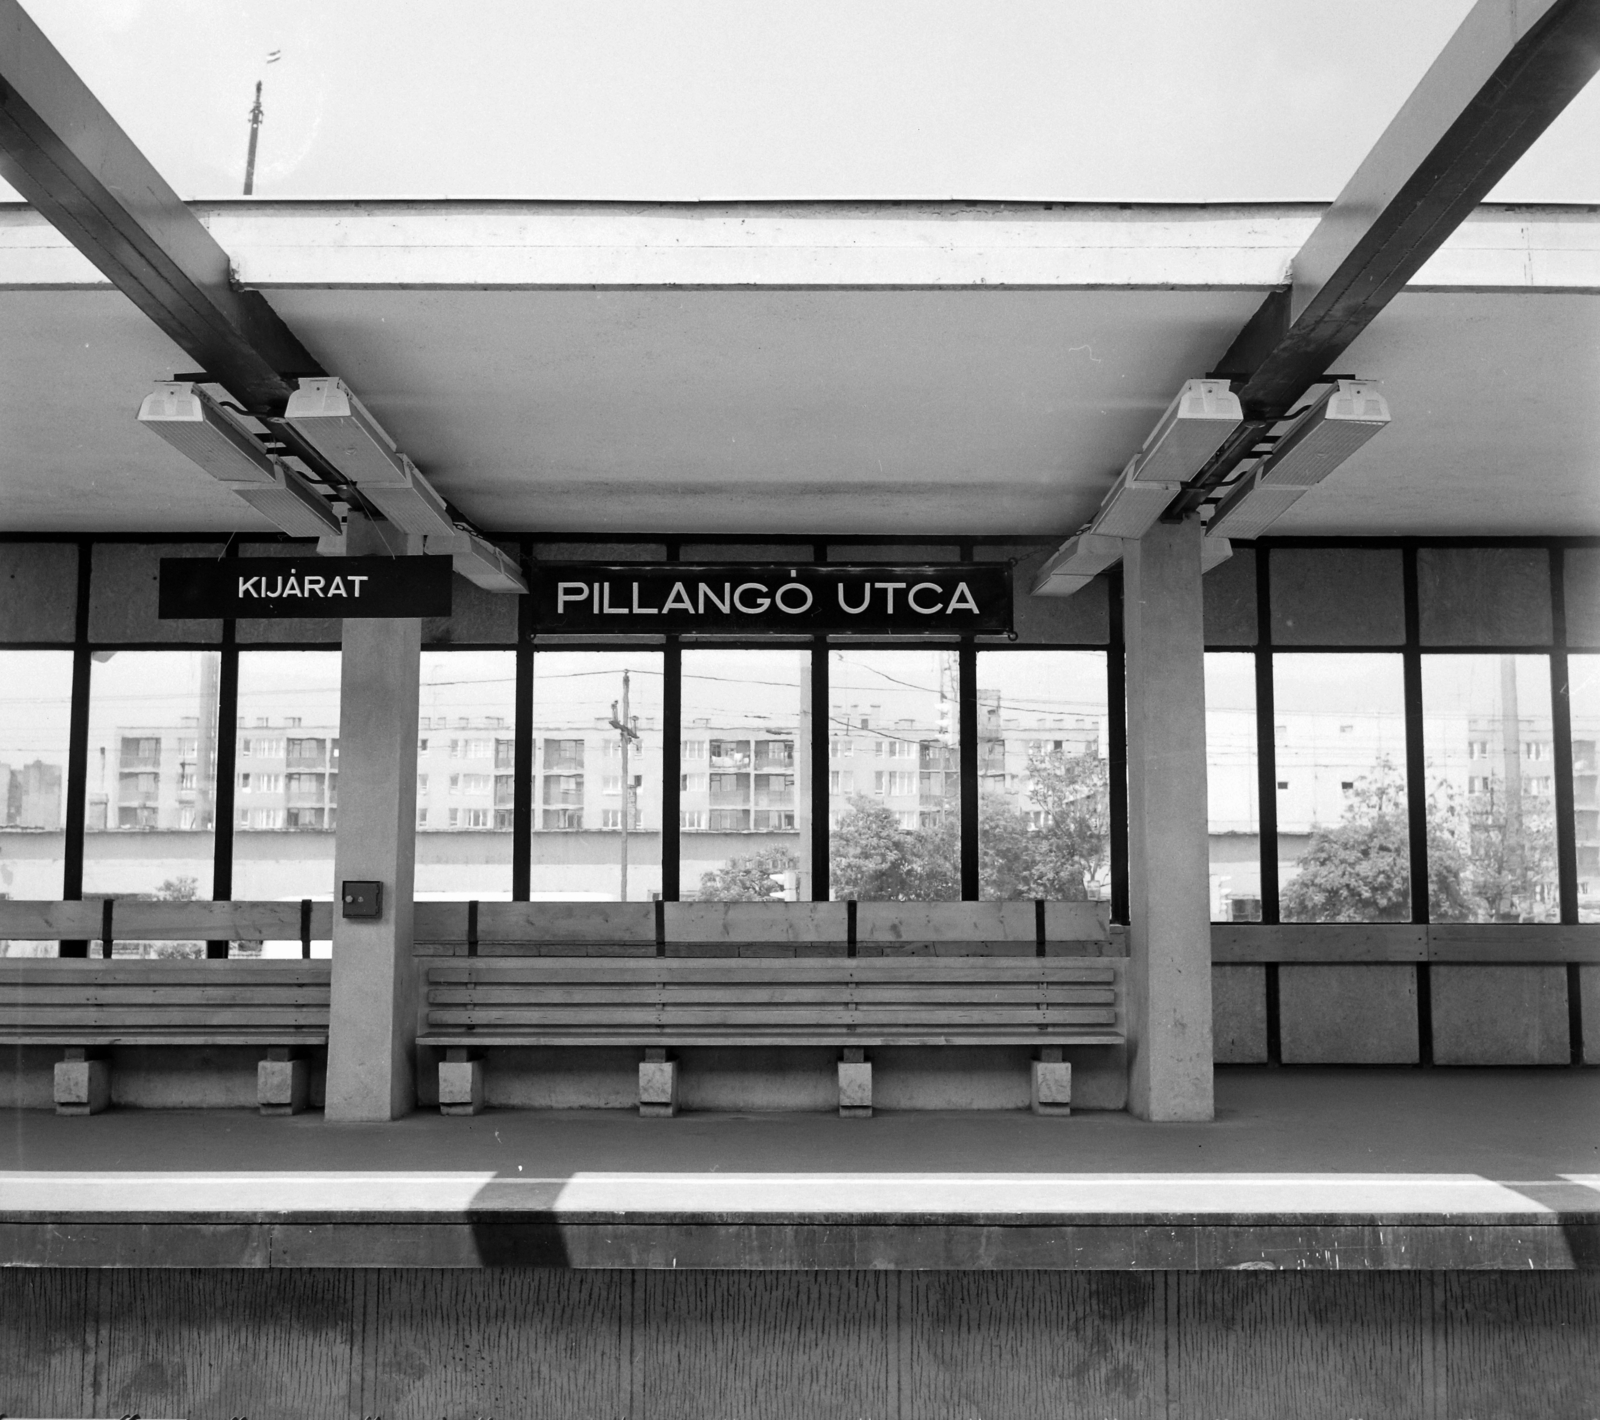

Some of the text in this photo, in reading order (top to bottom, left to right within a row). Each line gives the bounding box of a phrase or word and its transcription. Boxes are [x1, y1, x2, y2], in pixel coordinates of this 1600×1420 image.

[238, 568, 369, 598] KIJÁRAT
[557, 570, 980, 614] PILLANGÓ UTCA
